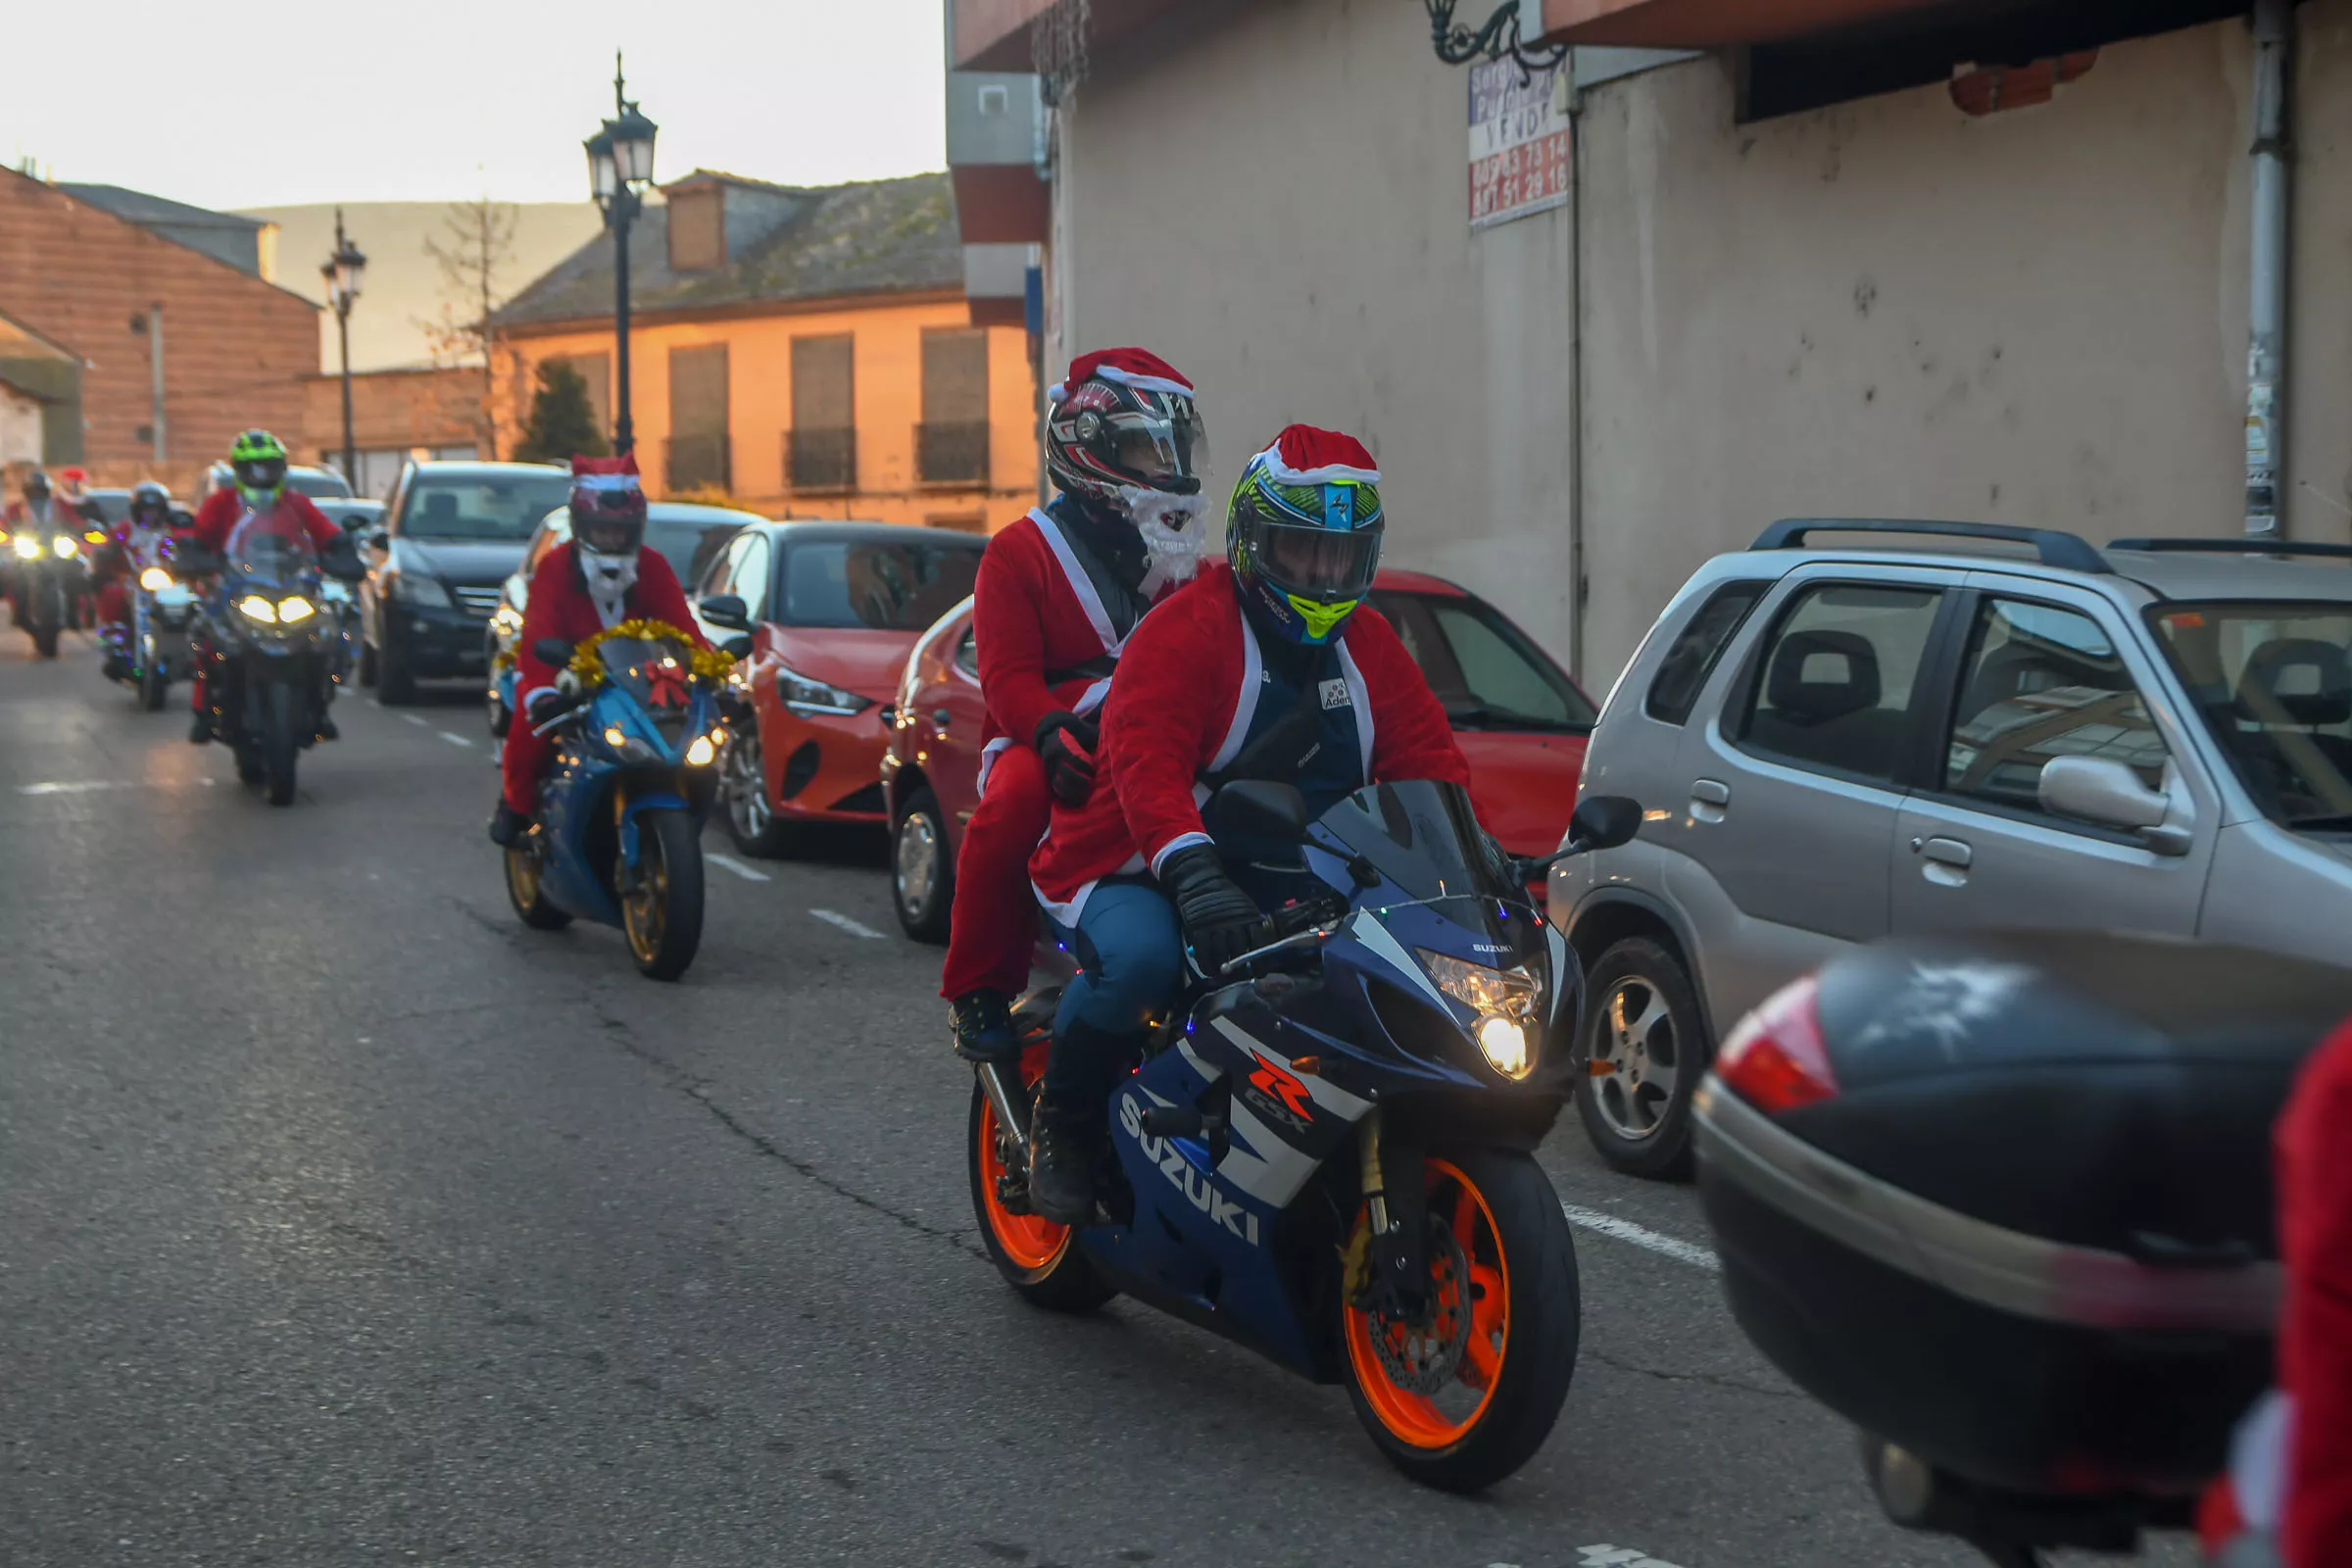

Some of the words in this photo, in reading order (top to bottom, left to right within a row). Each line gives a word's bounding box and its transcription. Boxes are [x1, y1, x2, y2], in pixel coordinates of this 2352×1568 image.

[1472, 943, 1514, 953] SUZUKI
[1245, 1087, 1311, 1135] GSX
[1120, 1092, 1258, 1248] SUZUKI
